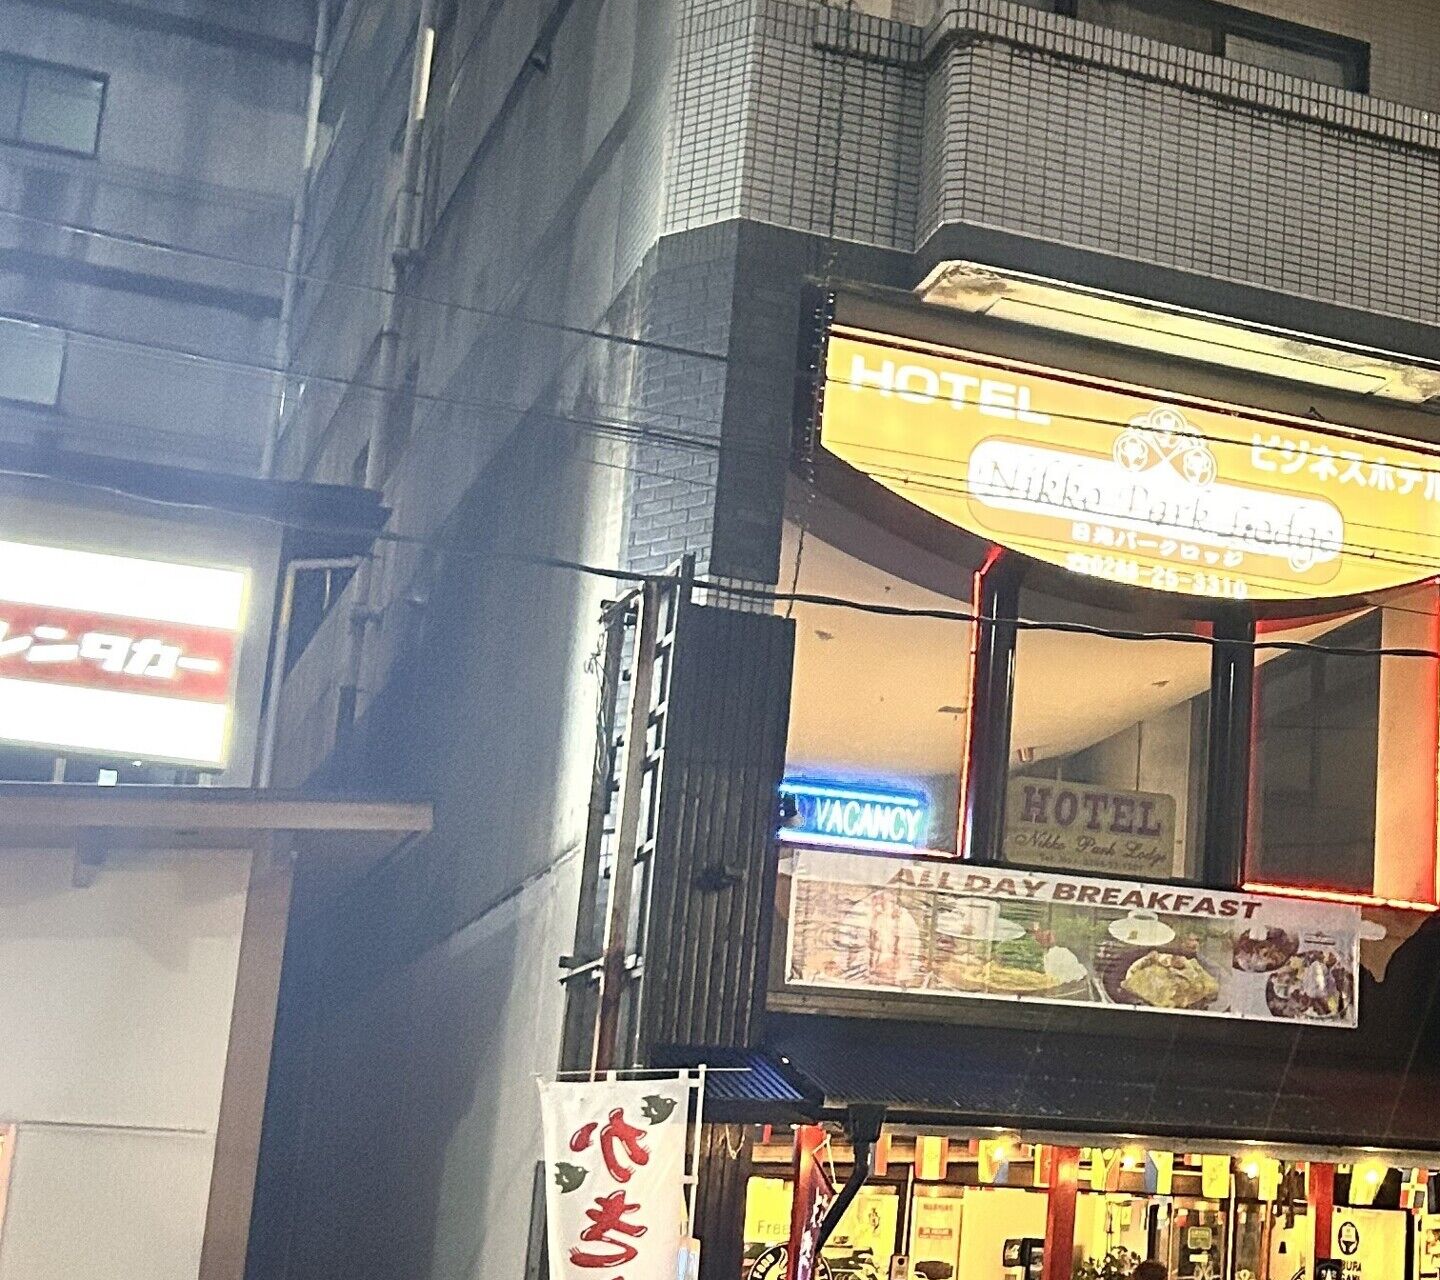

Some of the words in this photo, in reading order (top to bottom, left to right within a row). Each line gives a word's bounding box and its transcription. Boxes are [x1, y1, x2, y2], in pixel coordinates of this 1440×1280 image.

[849, 354, 1052, 426] HOTEL
[0, 624, 219, 680] レンタカー
[815, 797, 923, 842] VACANCY
[1021, 785, 1162, 837] HOTEL
[886, 867, 958, 892] ALL
[963, 874, 1047, 898] DAY
[1051, 881, 1263, 920] BREAKFAST
